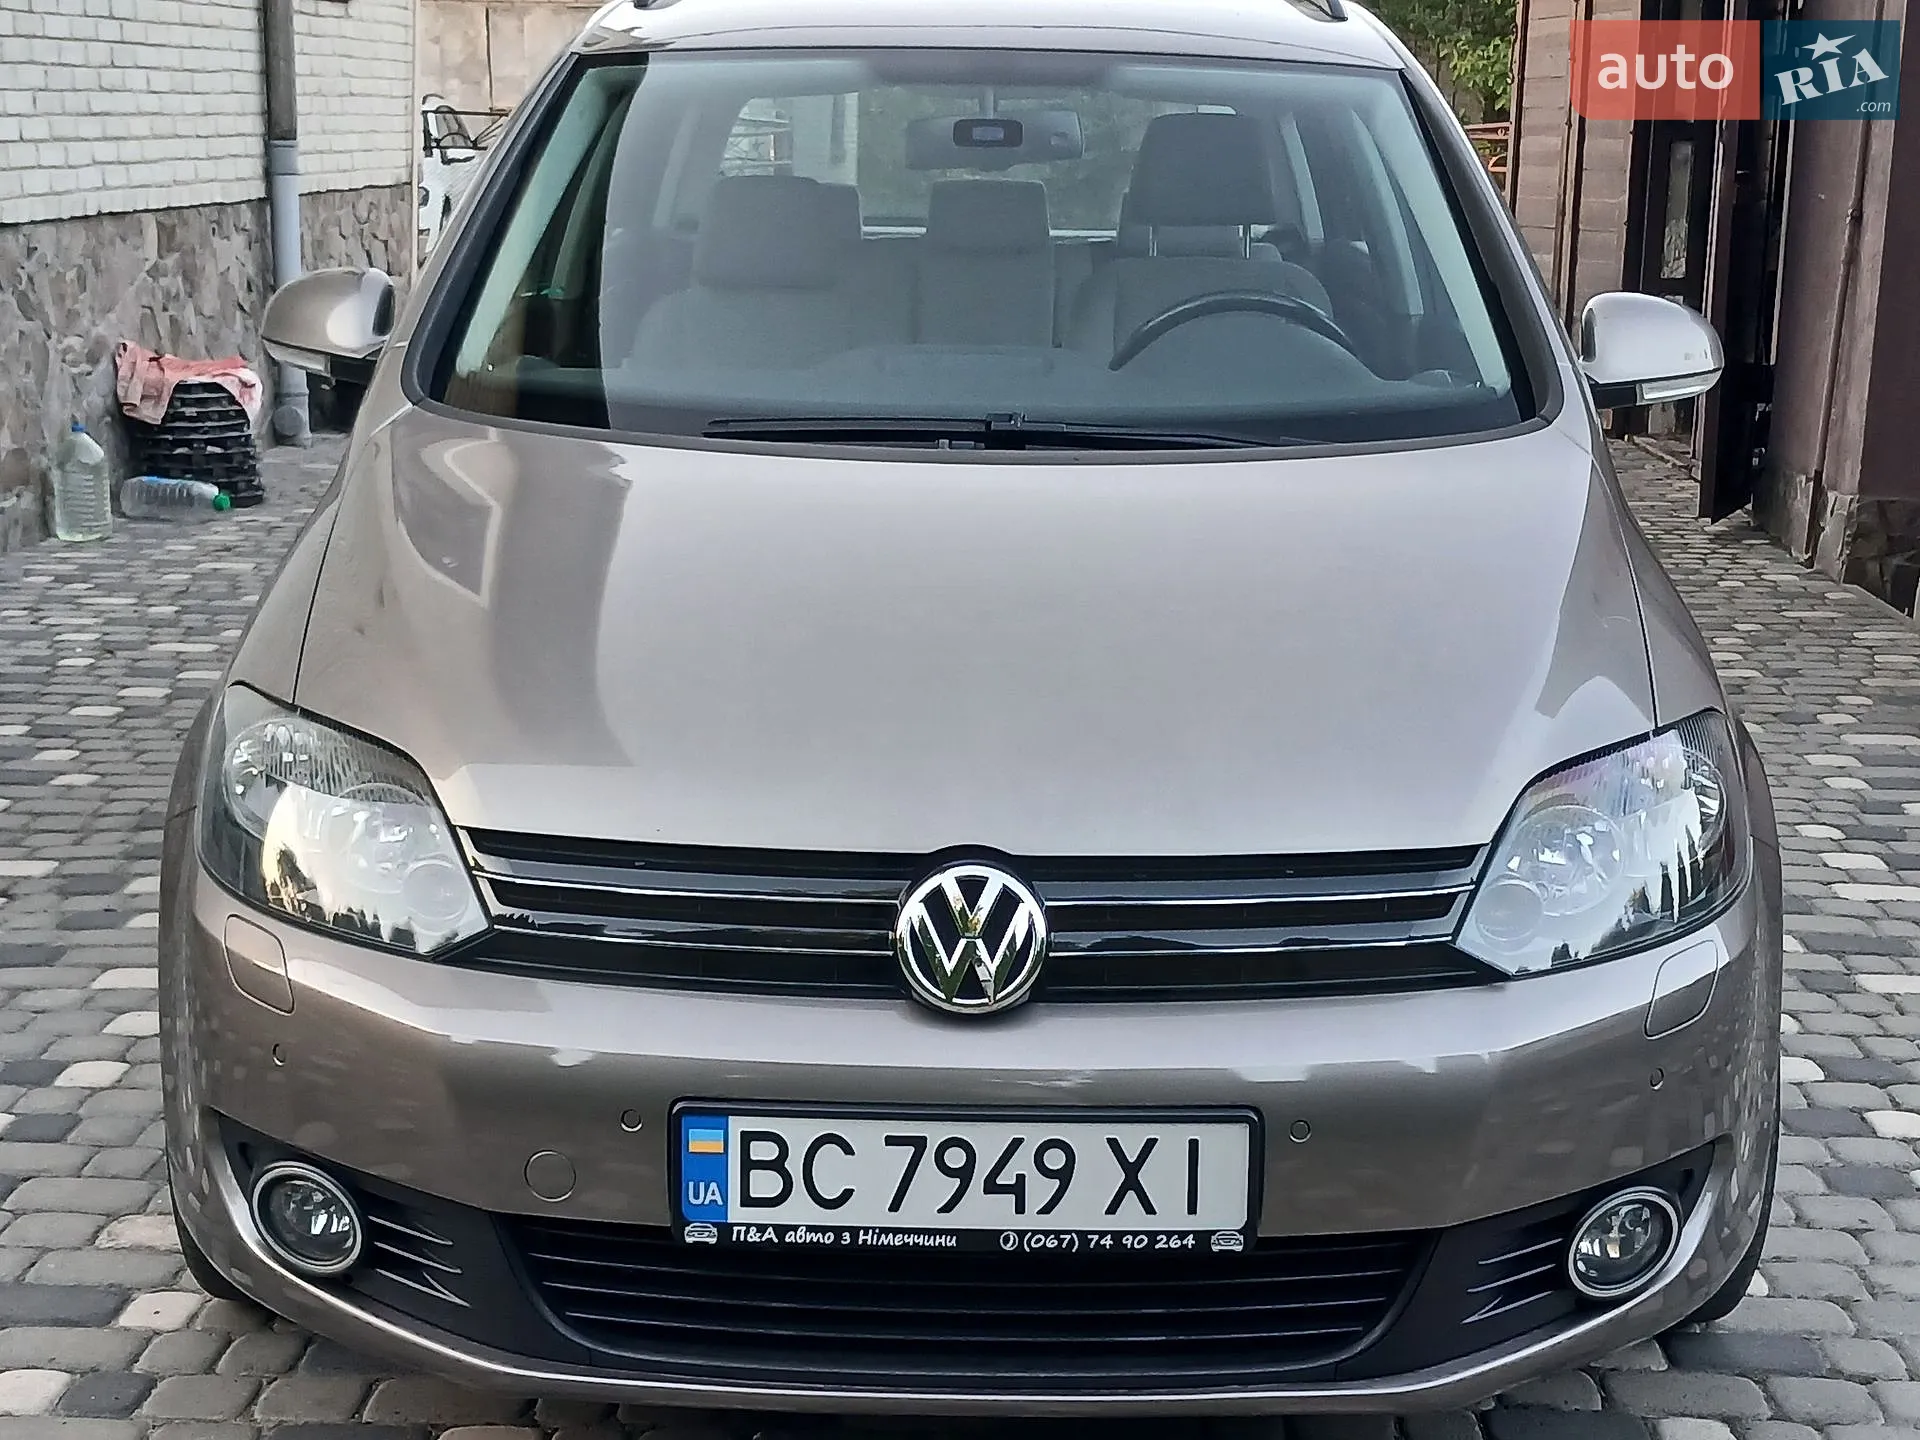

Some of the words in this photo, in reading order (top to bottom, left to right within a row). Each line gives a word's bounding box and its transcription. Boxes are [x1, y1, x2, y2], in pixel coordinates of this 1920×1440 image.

[739, 1130, 856, 1210] BC
[884, 1134, 1077, 1216] 7949
[688, 1181, 723, 1206] UA
[785, 1227, 835, 1245] авто
[858, 1229, 957, 1247] Німеччини
[1023, 1232, 1079, 1252] (067)
[1087, 1234, 1114, 1249] 74
[1122, 1234, 1149, 1249] 90
[1154, 1234, 1196, 1249] 264
